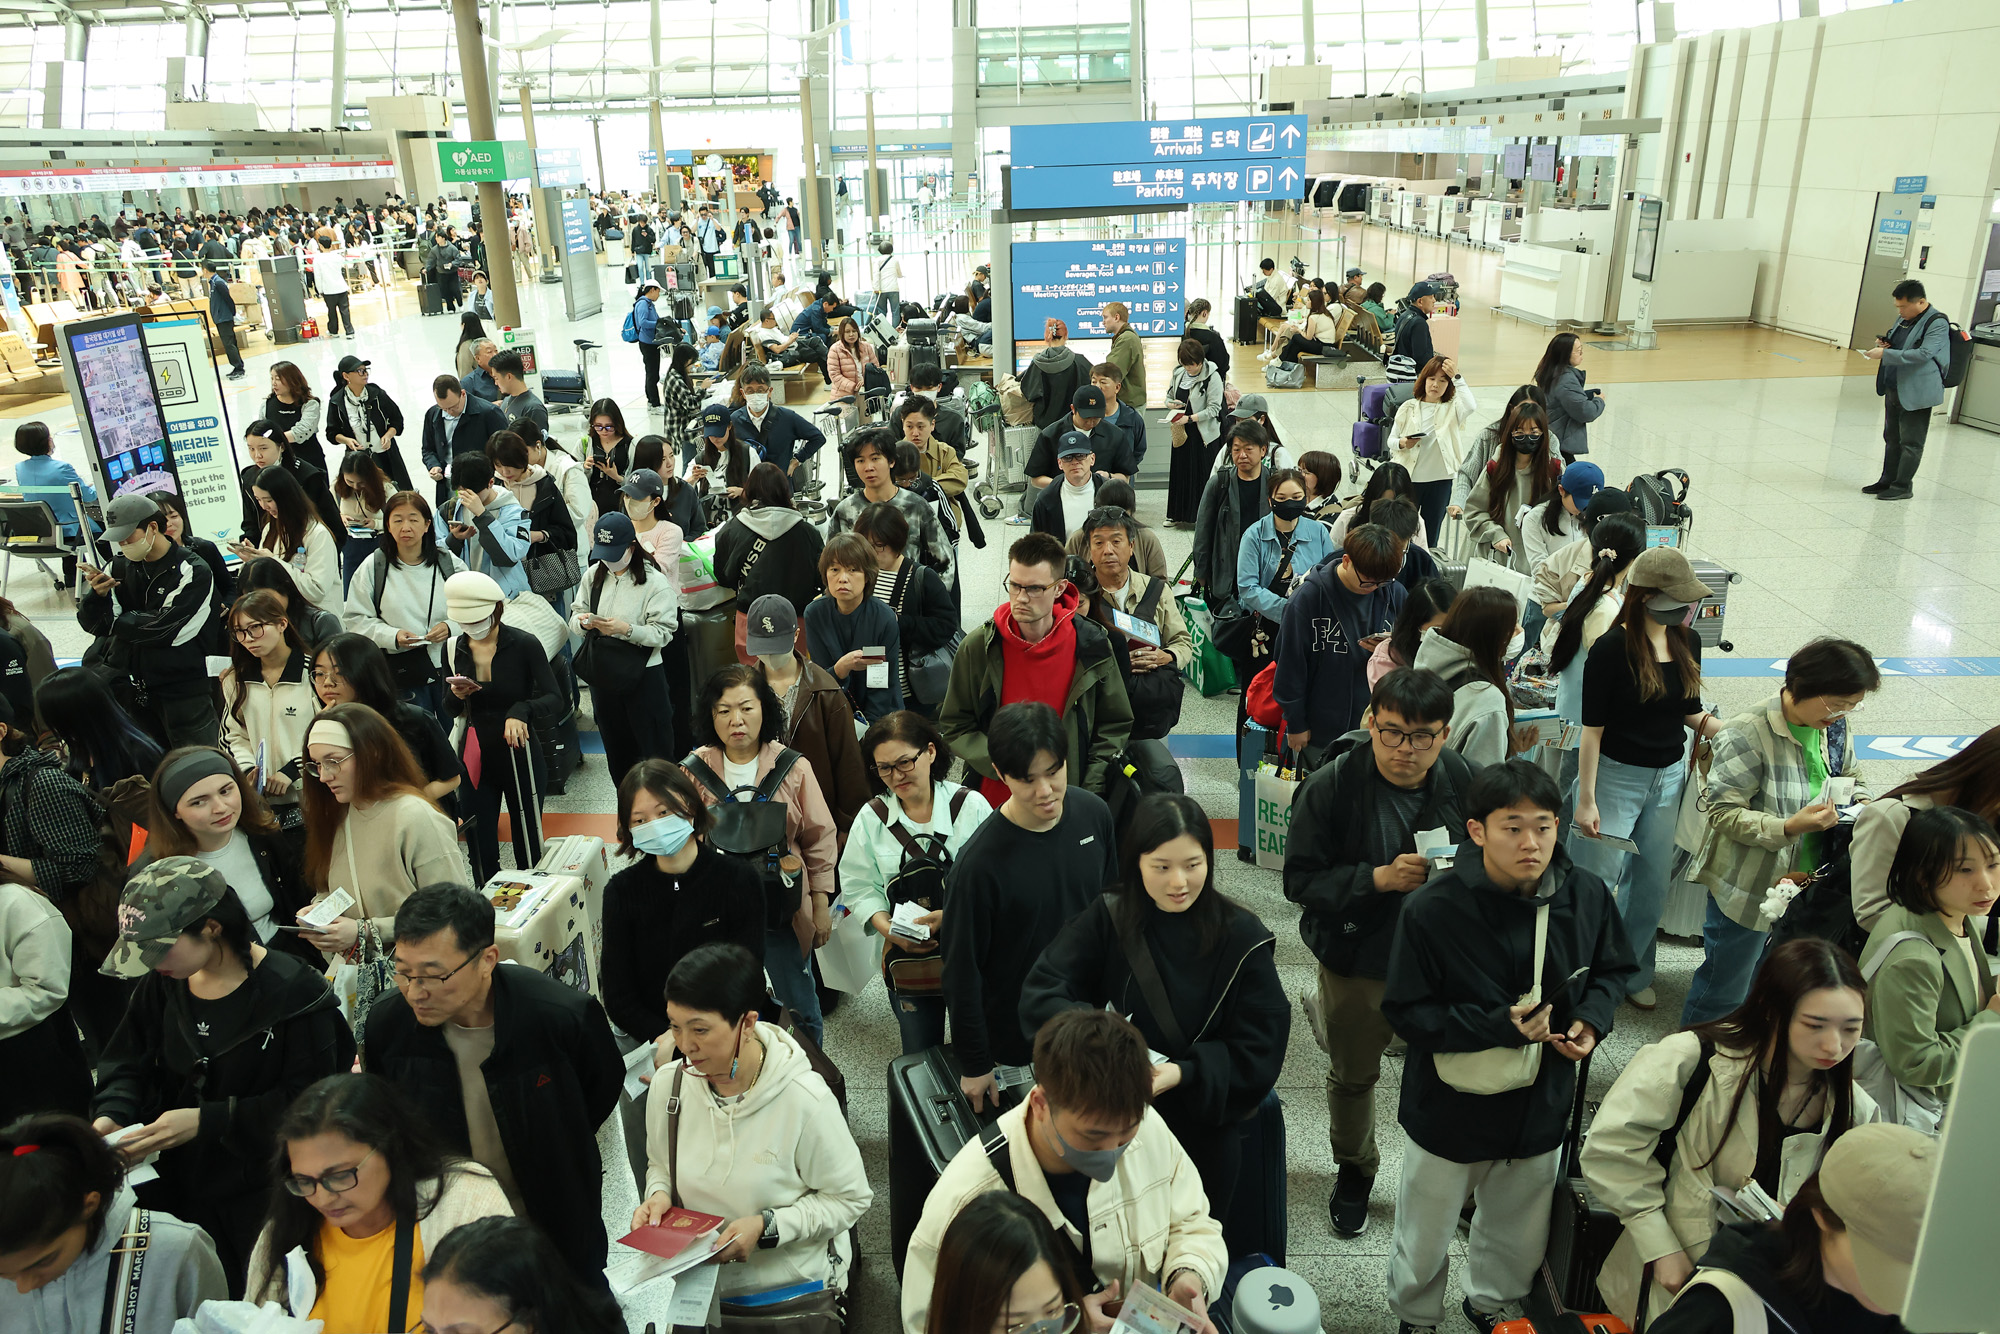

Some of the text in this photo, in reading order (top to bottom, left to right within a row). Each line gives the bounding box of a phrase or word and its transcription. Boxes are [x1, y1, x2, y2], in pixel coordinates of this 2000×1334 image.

[1210, 129, 1241, 148] 도착
[1153, 142, 1203, 156] Arrivals
[470, 153, 492, 163] AED
[454, 167, 495, 176] 자동심장충격기
[1190, 171, 1239, 191] 주차장
[1252, 170, 1268, 190] P
[1136, 184, 1184, 199] Parking
[1106, 249, 1126, 257] Toilets
[1128, 244, 1150, 253] 화장실
[1065, 269, 1114, 278] Beverages, Food
[1116, 264, 1149, 274] 음료, 식사
[1033, 290, 1096, 299] Meeting Point (West)
[1098, 285, 1118, 294] 만남의
[1134, 302, 1150, 312] 환전
[170, 418, 215, 433] 여행을 위해
[190, 474, 208, 487] put
[208, 472, 225, 483] the
[192, 485, 216, 496] bank
[217, 482, 227, 492] in
[207, 494, 226, 506] bag
